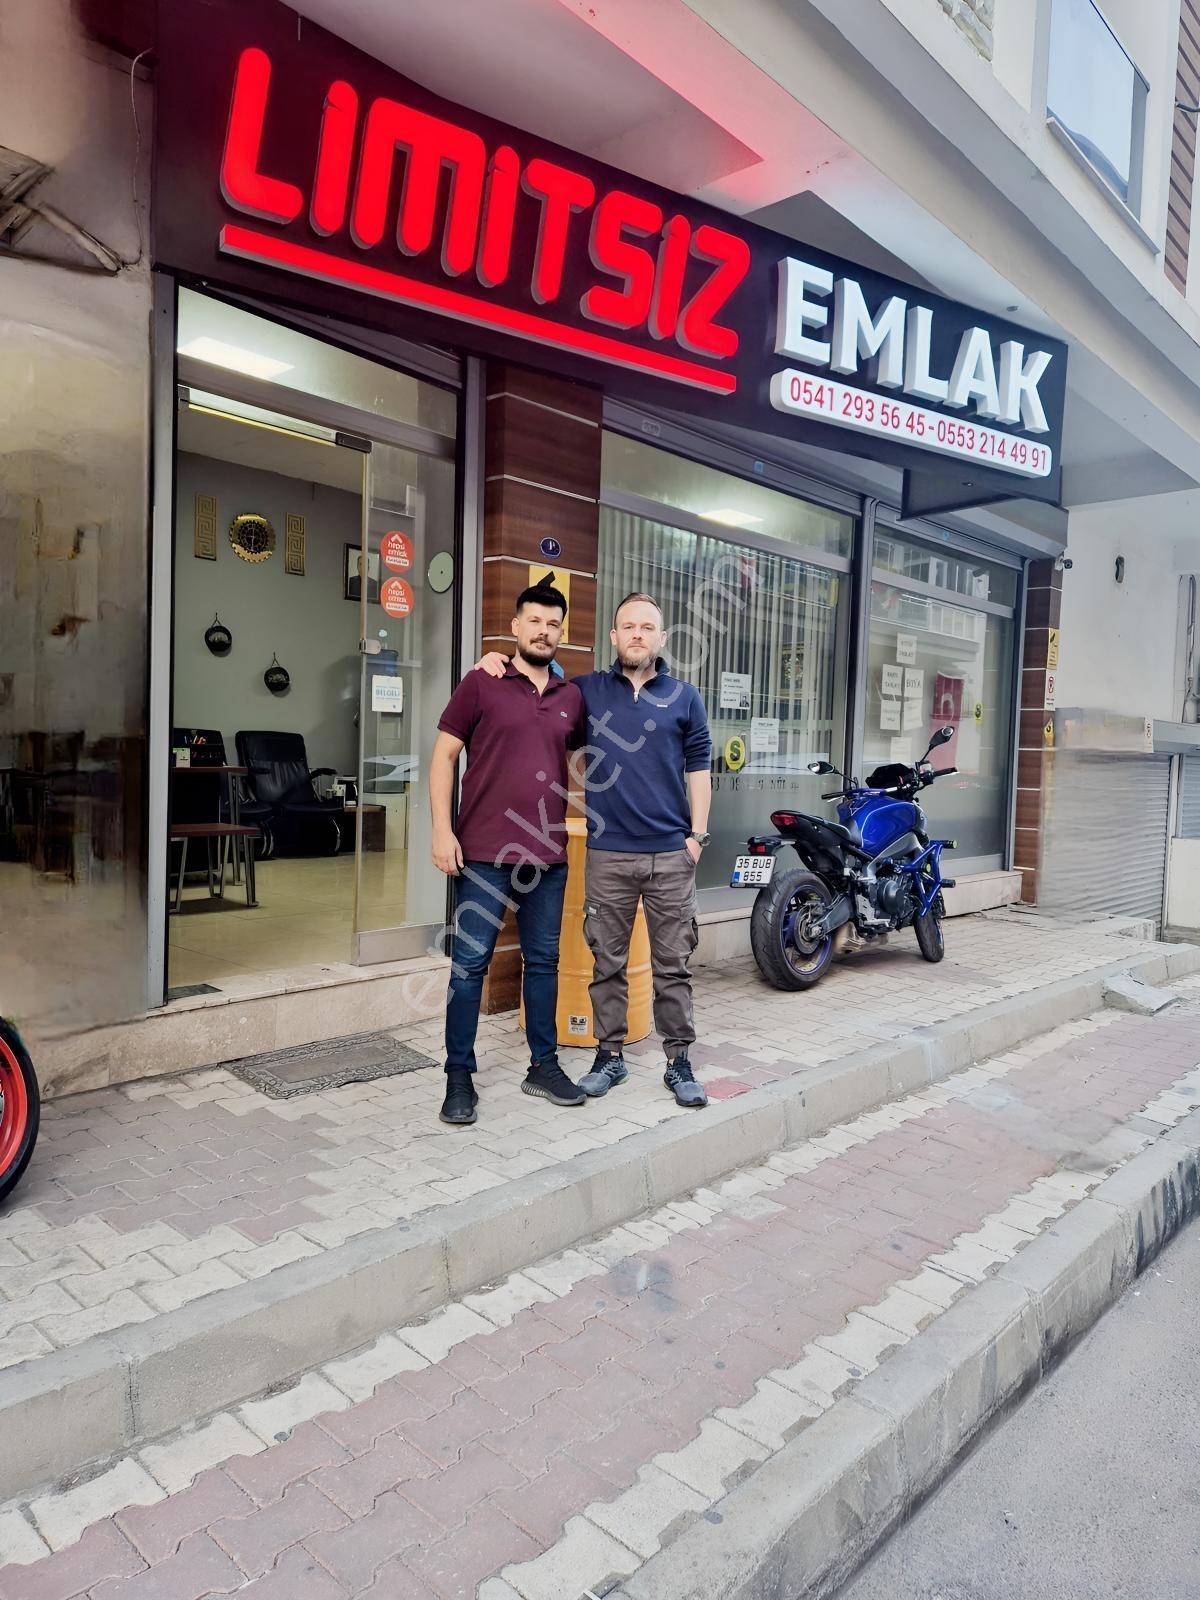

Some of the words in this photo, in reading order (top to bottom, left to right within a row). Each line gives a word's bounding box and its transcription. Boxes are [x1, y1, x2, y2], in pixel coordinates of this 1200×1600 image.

[774, 256, 1053, 433] EMLAK
[790, 377, 834, 411] 0541
[842, 391, 875, 422] 293
[880, 403, 900, 430] 56
[979, 432, 1006, 459] 214
[1010, 442, 1027, 465] 49
[1031, 448, 1047, 471] 91
[729, 740, 741, 761] S
[737, 858, 750, 868] 35
[752, 858, 772, 869] BUB
[743, 871, 763, 882] 855
